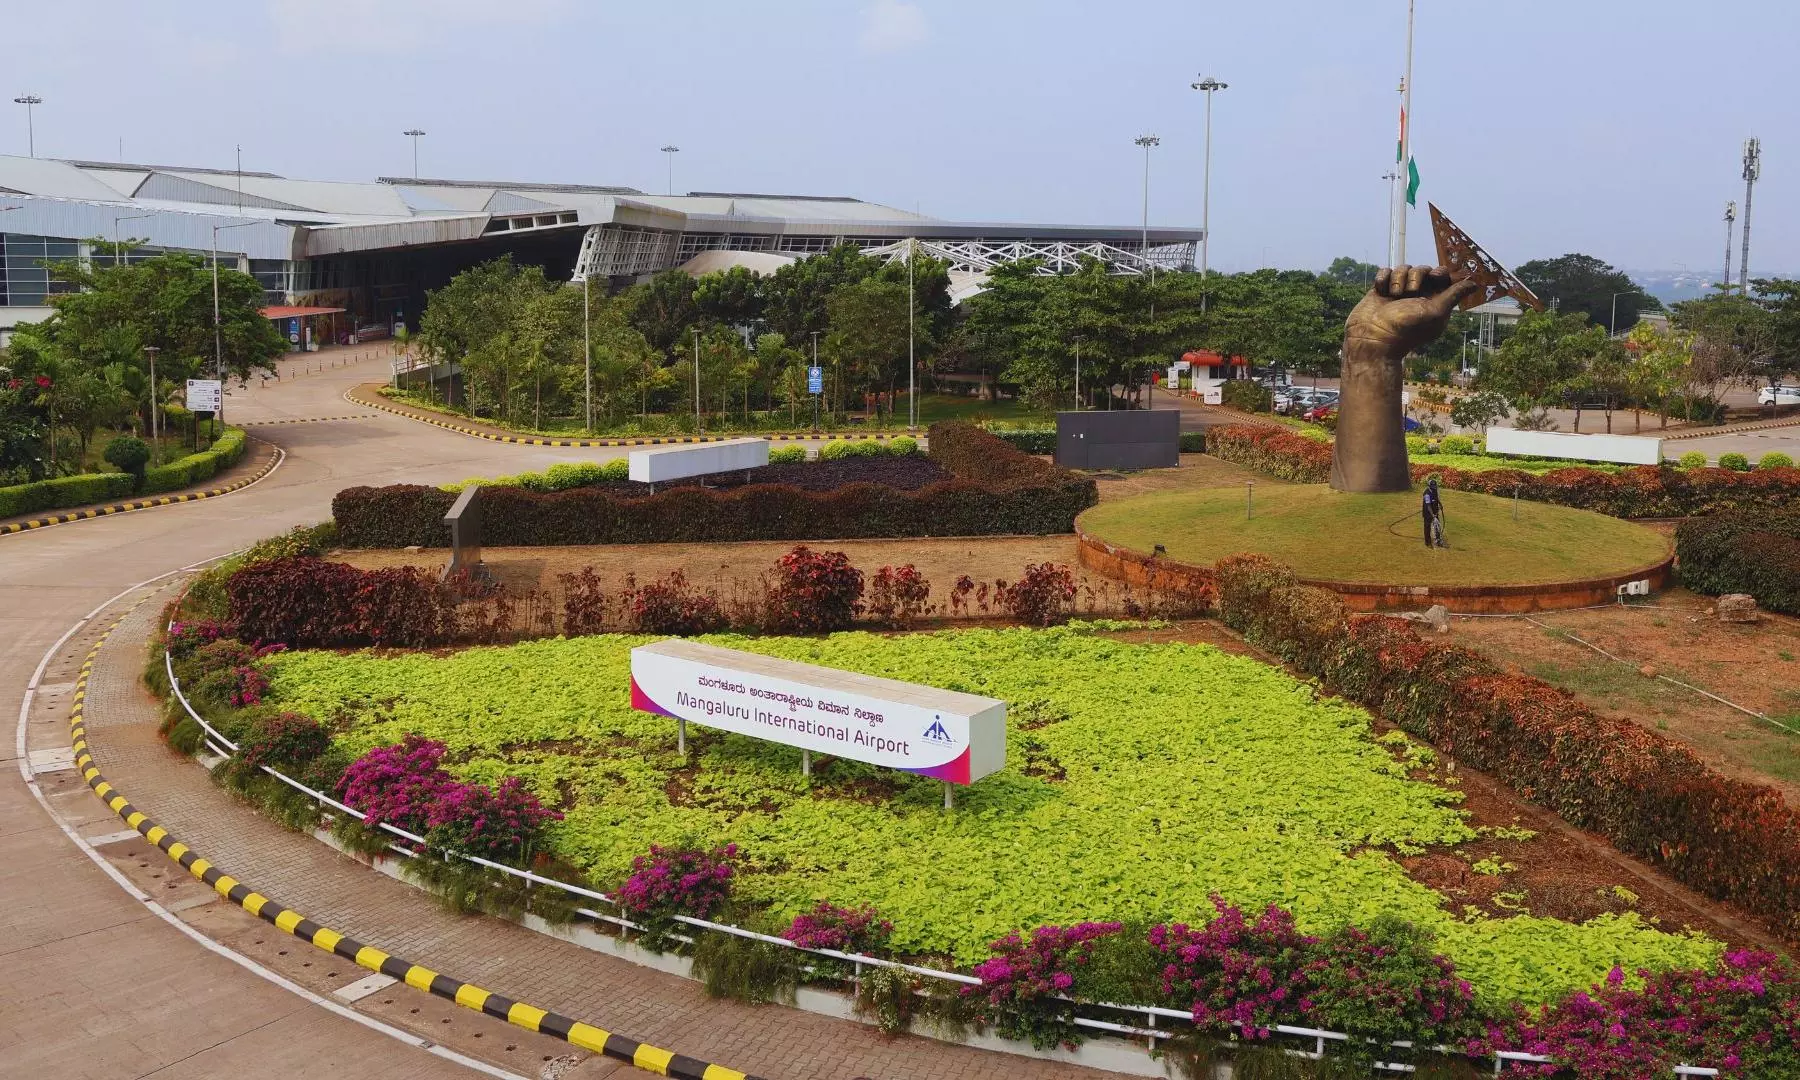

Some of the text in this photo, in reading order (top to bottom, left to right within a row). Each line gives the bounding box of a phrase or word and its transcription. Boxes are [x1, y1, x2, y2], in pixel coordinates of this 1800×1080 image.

[676, 691, 749, 720] Mangaluru
[754, 707, 849, 742] International
[854, 730, 909, 755] Airport
[698, 676, 746, 694] ಮಂಗಳೂರು
[817, 700, 850, 716] ವಿಮಾನ
[854, 707, 884, 727] ನಿಲ್ದಾಣ
